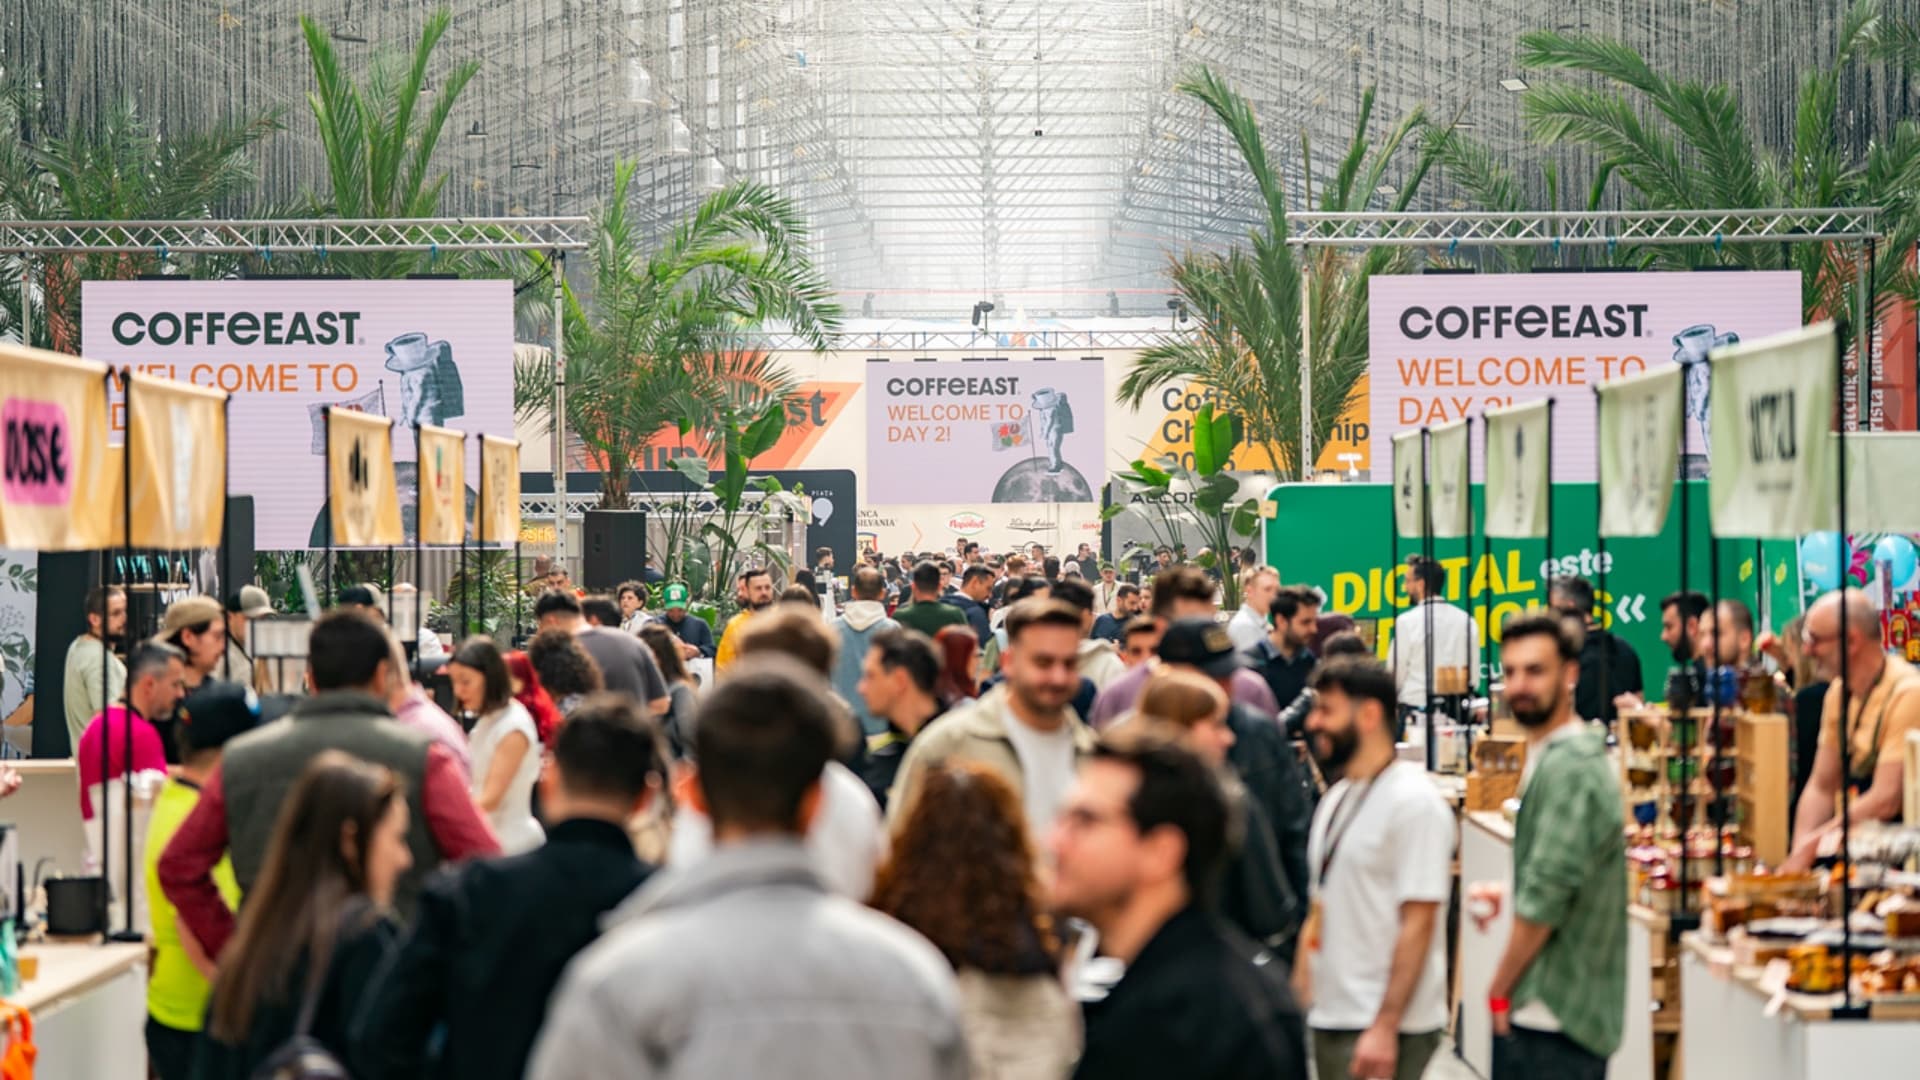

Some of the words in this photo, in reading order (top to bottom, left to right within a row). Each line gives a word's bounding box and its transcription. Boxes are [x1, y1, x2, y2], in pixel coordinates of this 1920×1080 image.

[307, 363, 358, 392] TO
[1397, 357, 1586, 386] WELCOME
[1595, 355, 1646, 385] TO
[888, 404, 990, 421] WELCOME
[996, 404, 1024, 421] TO
[1161, 387, 1247, 412] Coff
[1399, 396, 1473, 425] DAY
[888, 426, 928, 442] DAY
[935, 426, 951, 442] 2!
[1332, 550, 1536, 615] DIGTAL
[1539, 548, 1613, 581] este
